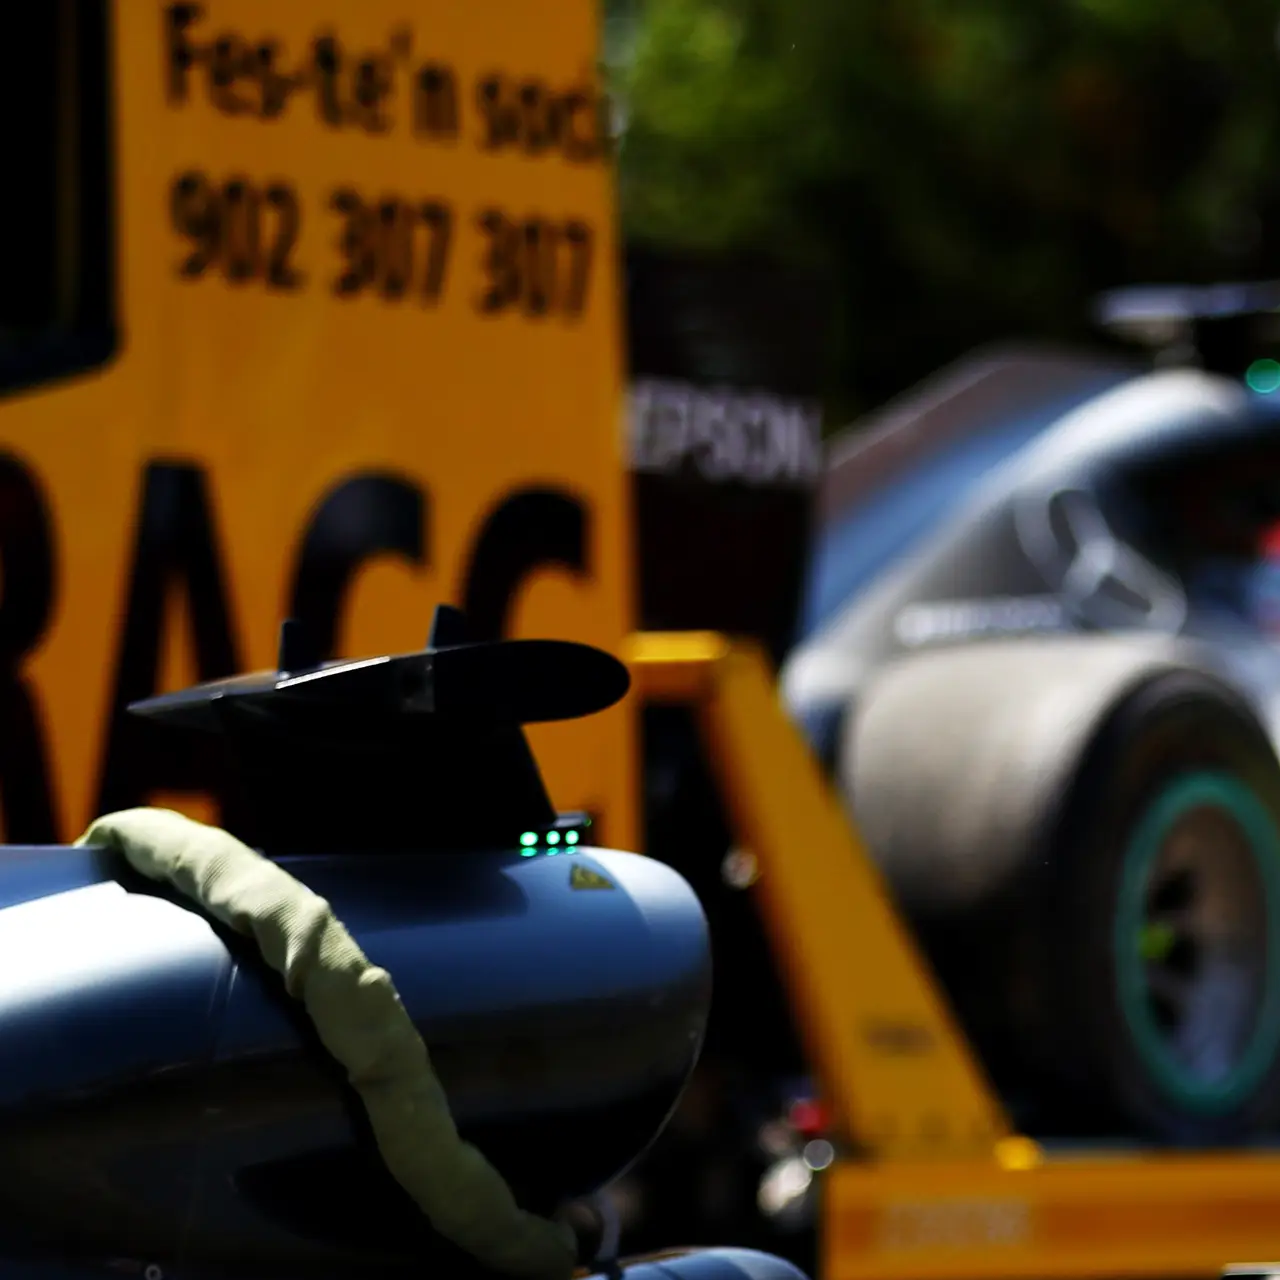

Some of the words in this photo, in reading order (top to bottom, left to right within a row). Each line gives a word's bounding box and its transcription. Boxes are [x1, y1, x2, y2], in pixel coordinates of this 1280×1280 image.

[476, 72, 612, 166] soc
[169, 170, 304, 290] 902
[328, 188, 454, 306] 307
[474, 208, 594, 322] 307
